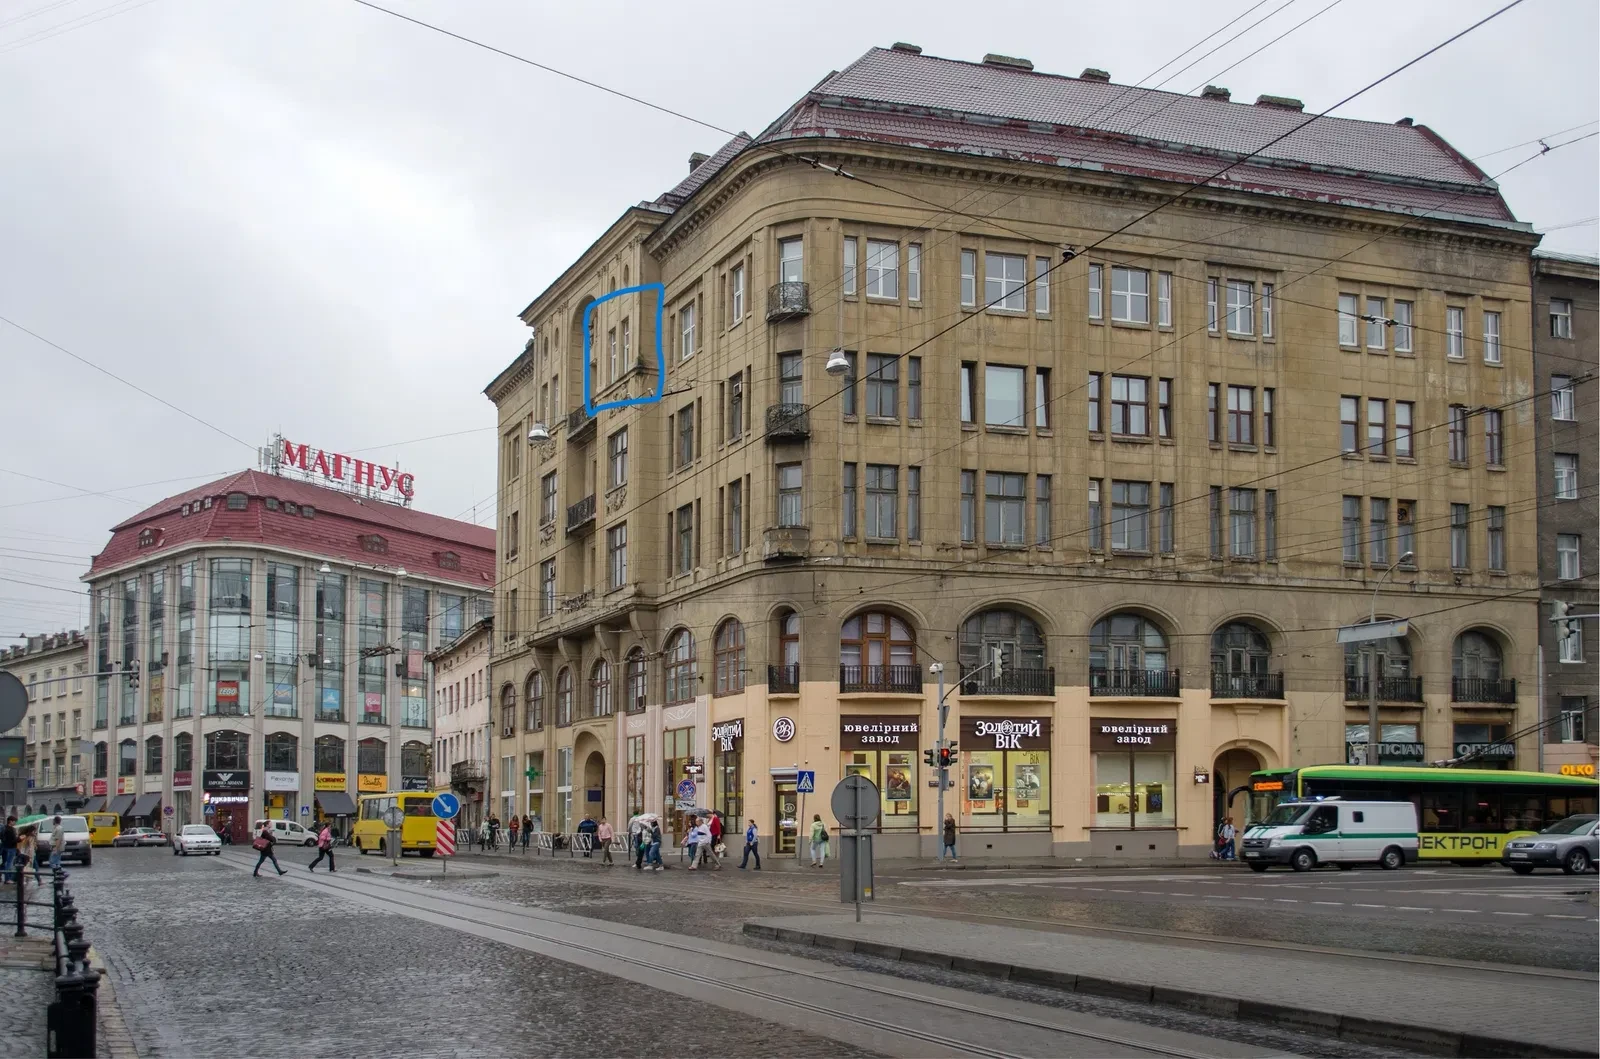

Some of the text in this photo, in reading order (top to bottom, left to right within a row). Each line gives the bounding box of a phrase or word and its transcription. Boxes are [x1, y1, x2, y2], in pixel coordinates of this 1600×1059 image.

[282, 440, 415, 498] МАГНУС
[844, 722, 918, 734] ювелірний
[976, 719, 1041, 737] Золотий
[1101, 724, 1168, 735] ювелірний
[861, 735, 900, 744] завод
[995, 733, 1022, 749] ВІК
[1116, 736, 1152, 744] завод
[210, 795, 249, 804] рукавичка
